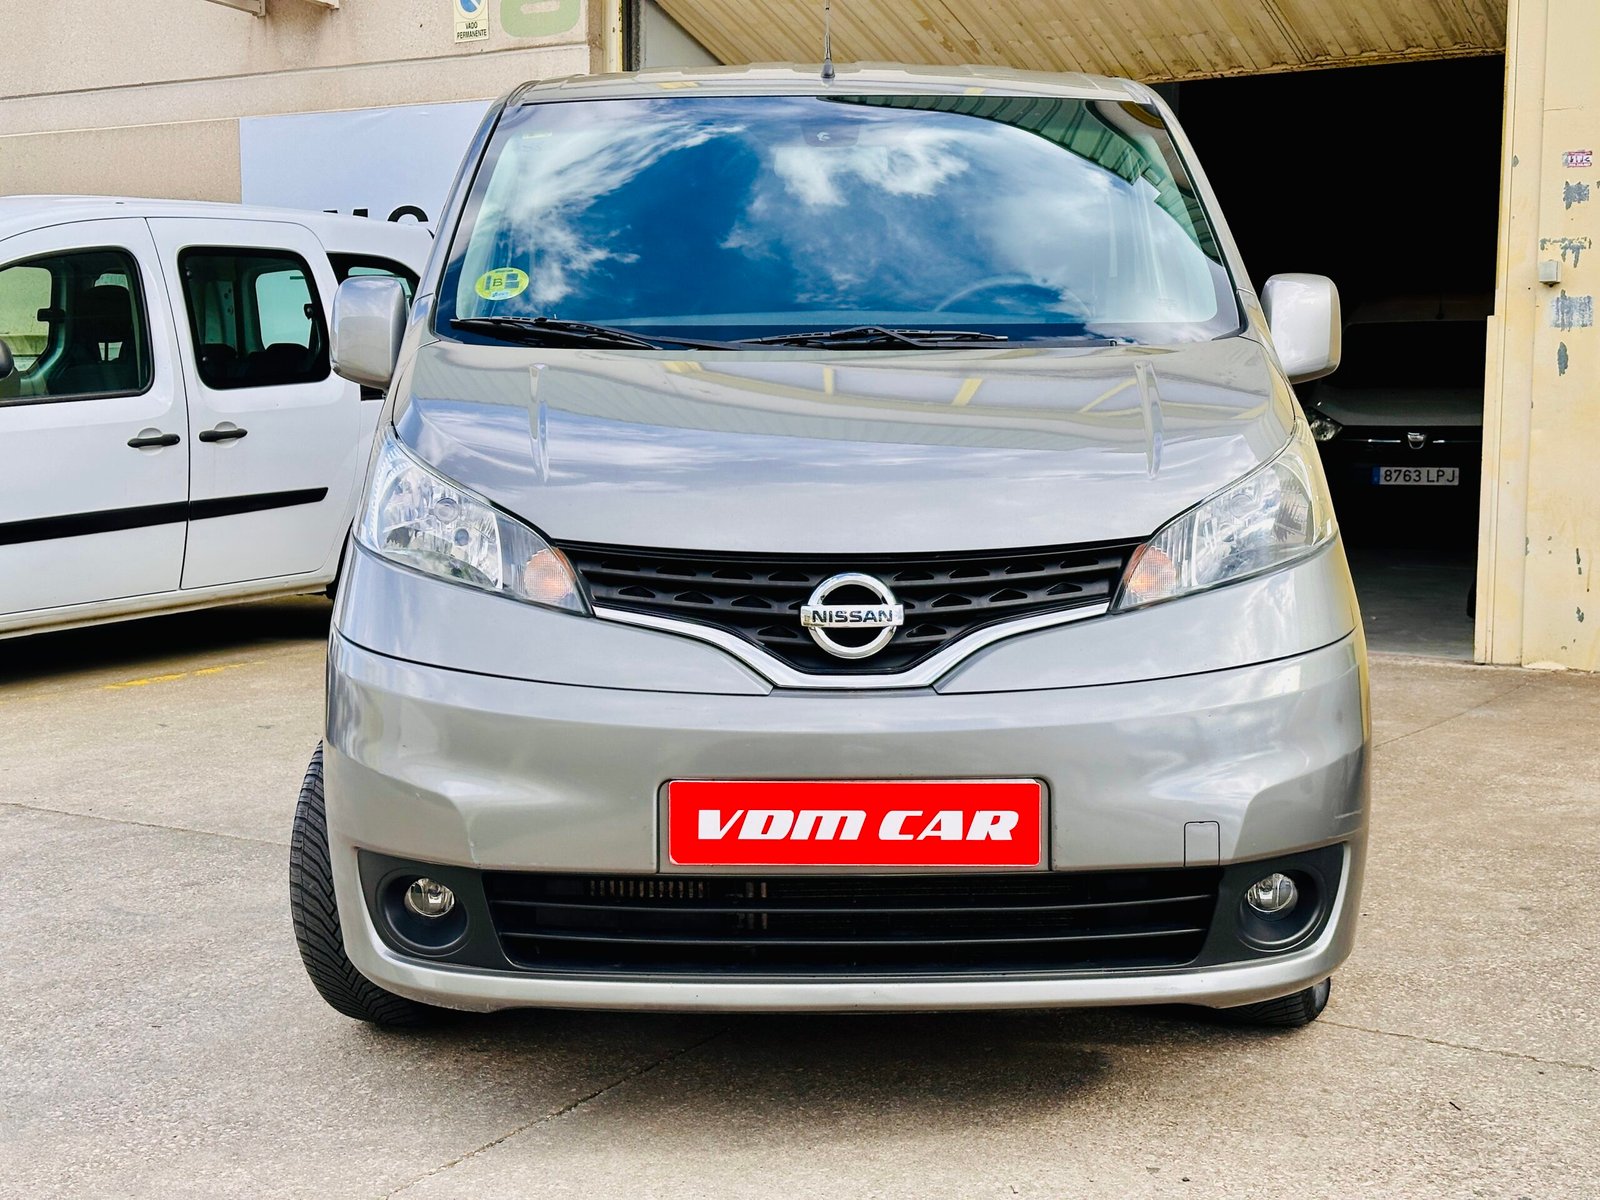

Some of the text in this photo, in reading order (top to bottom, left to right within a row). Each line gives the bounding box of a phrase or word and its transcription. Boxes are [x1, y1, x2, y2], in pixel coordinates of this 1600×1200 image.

[465, 21, 478, 29] VADO
[457, 29, 487, 39] PERMANENTE
[493, 278, 503, 287] B
[1384, 469, 1455, 483] 8763 LPJ
[812, 610, 893, 623] NISSAN
